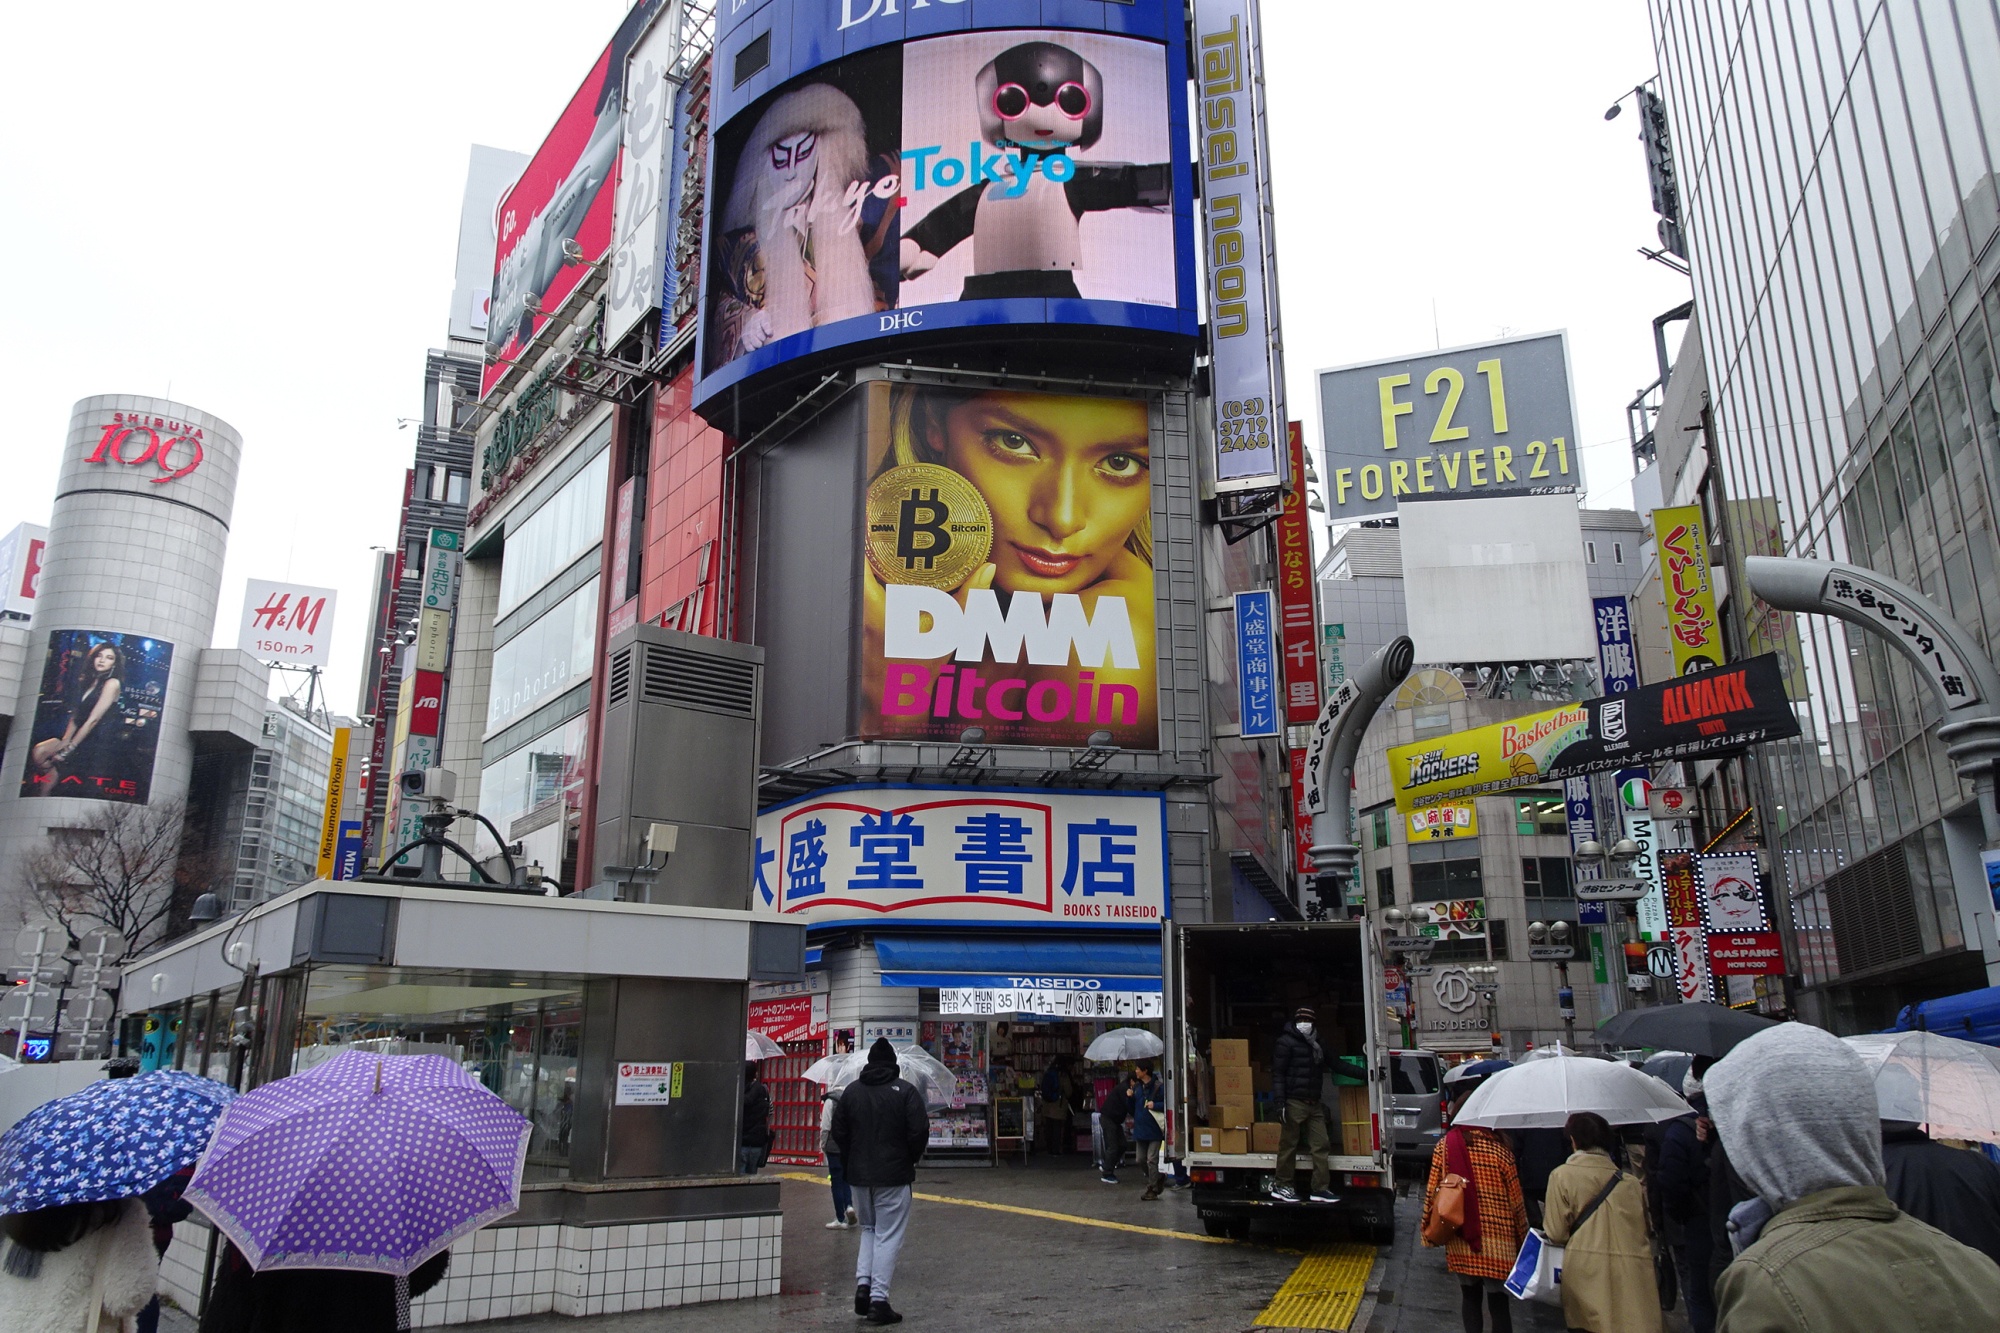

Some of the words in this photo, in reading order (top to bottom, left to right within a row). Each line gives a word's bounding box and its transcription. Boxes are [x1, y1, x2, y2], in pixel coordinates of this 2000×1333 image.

[1201, 15, 1249, 181] Taisei
[901, 141, 1076, 198] Tokyo
[1210, 193, 1250, 340] neon
[879, 311, 924, 333] DHC
[113, 411, 205, 440] SHIBUYA
[1220, 415, 1269, 436] 3719
[1222, 398, 1265, 418] (03)
[84, 422, 205, 484] 109
[1220, 433, 1270, 453] 2468
[1335, 445, 1517, 505] FOREVER
[1526, 437, 1569, 480] 21
[950, 524, 986, 533] Bitcoin
[1663, 524, 1712, 648] くいしんぼ
[252, 592, 327, 636] H&M
[884, 583, 1141, 670] DMM
[429, 613, 441, 660] Euphoria
[1284, 603, 1318, 708] 三千里
[1833, 579, 1967, 697] 渋谷センター街
[1243, 600, 1271, 729] 大盛堂商事ビル
[1329, 647, 1345, 685] 渋谷西村
[415, 696, 439, 709] JTB
[491, 657, 568, 723] Euphoria
[880, 662, 1140, 725] Bitcoin
[1662, 670, 1755, 726] ALVARK
[1307, 685, 1352, 809] 渋谷センター街
[1423, 749, 1442, 762] SUN
[1500, 708, 1588, 761] Basketball
[1538, 724, 1589, 774] STREET
[32, 774, 138, 790] KATE
[329, 757, 344, 797] KiYoshi
[1401, 752, 1481, 790] ROCKERS
[322, 797, 339, 860] Matsumoto
[1427, 808, 1454, 825] 麻雀
[753, 812, 1138, 906] 大盛堂書店
[1580, 882, 1645, 894] 渋谷センター街
[1668, 879, 1683, 926] ハンバーグ
[1063, 904, 1102, 917] BOOKS
[1106, 904, 1158, 918] TAISEIDO
[1713, 949, 1740, 958] GAS
[1740, 948, 1779, 958] PANIC
[1731, 938, 1757, 946] CLUB
[1007, 977, 1102, 990] TAISEIDO
[1674, 930, 1699, 999] ラーメン
[749, 1000, 810, 1017] リクルートのフリーペーパー
[941, 990, 959, 1002] HUN
[974, 990, 993, 1002] HUN
[998, 993, 1013, 1009] 35
[1016, 991, 1072, 1014] ハイキュー!!
[941, 1002, 959, 1013] TER
[975, 1002, 993, 1013] TER
[633, 1066, 668, 1076] 路上演奏禁止
